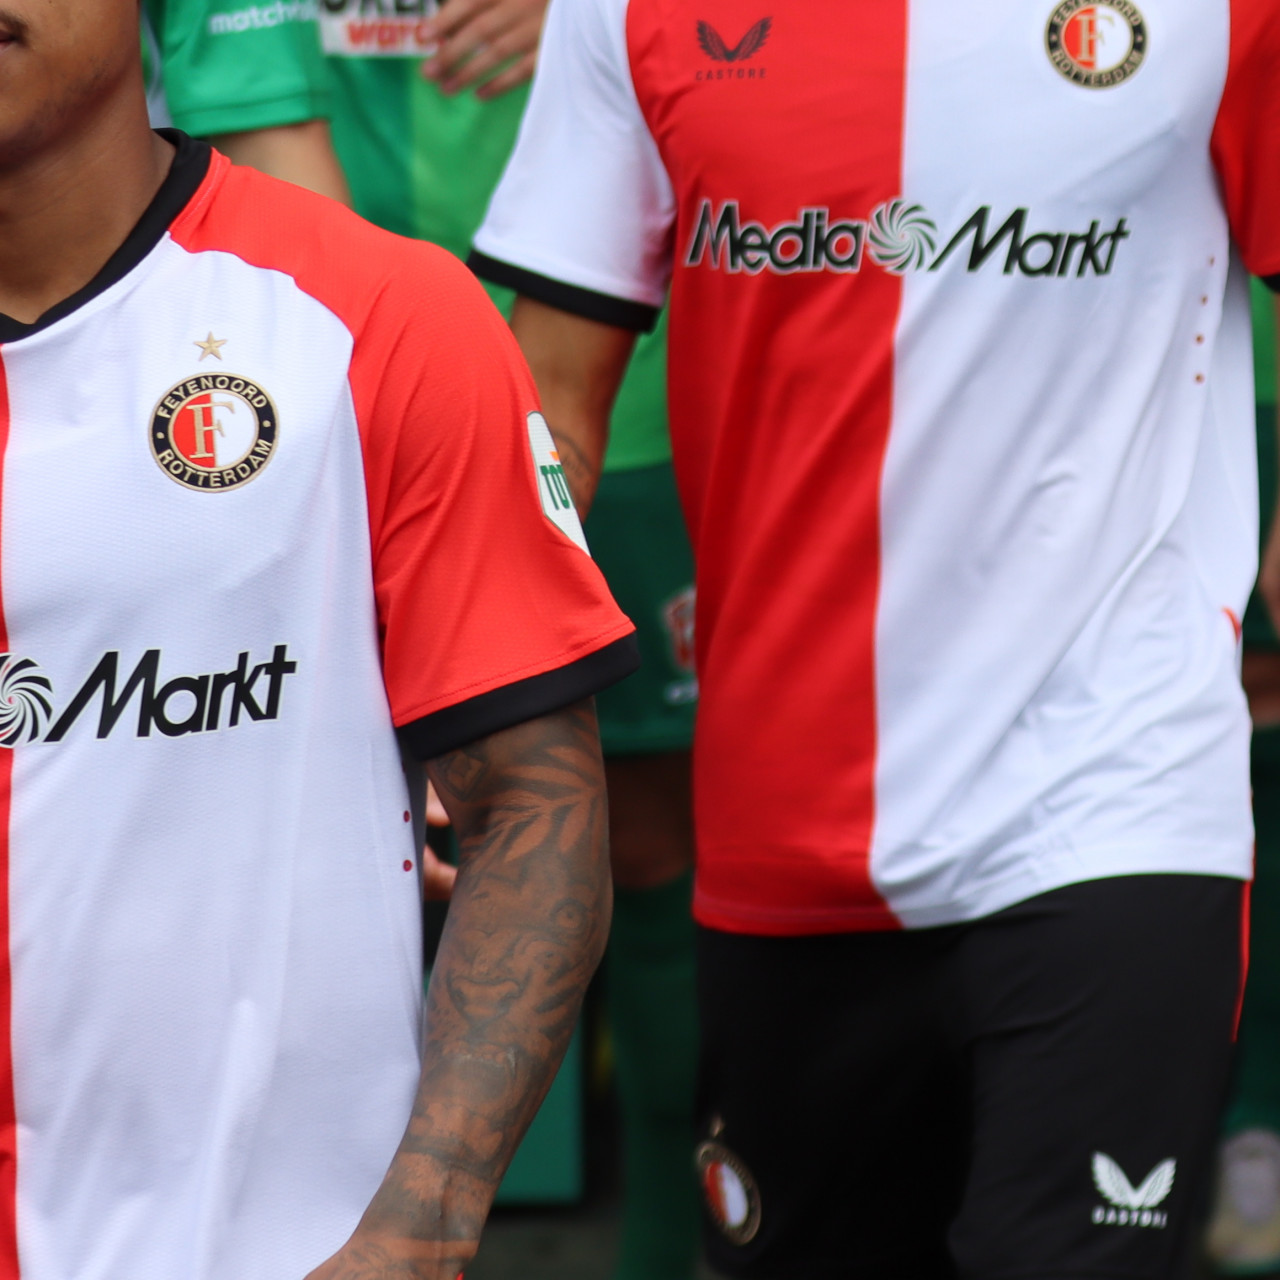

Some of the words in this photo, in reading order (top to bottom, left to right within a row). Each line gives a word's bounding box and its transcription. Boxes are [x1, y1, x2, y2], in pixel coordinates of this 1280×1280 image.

[695, 67, 767, 82] CASTORE
[684, 198, 863, 276] Media
[926, 203, 1131, 279] Markt
[156, 375, 268, 419] FEYENOORD
[158, 438, 273, 488] ROTTERDAM
[41, 643, 298, 745] Markt
